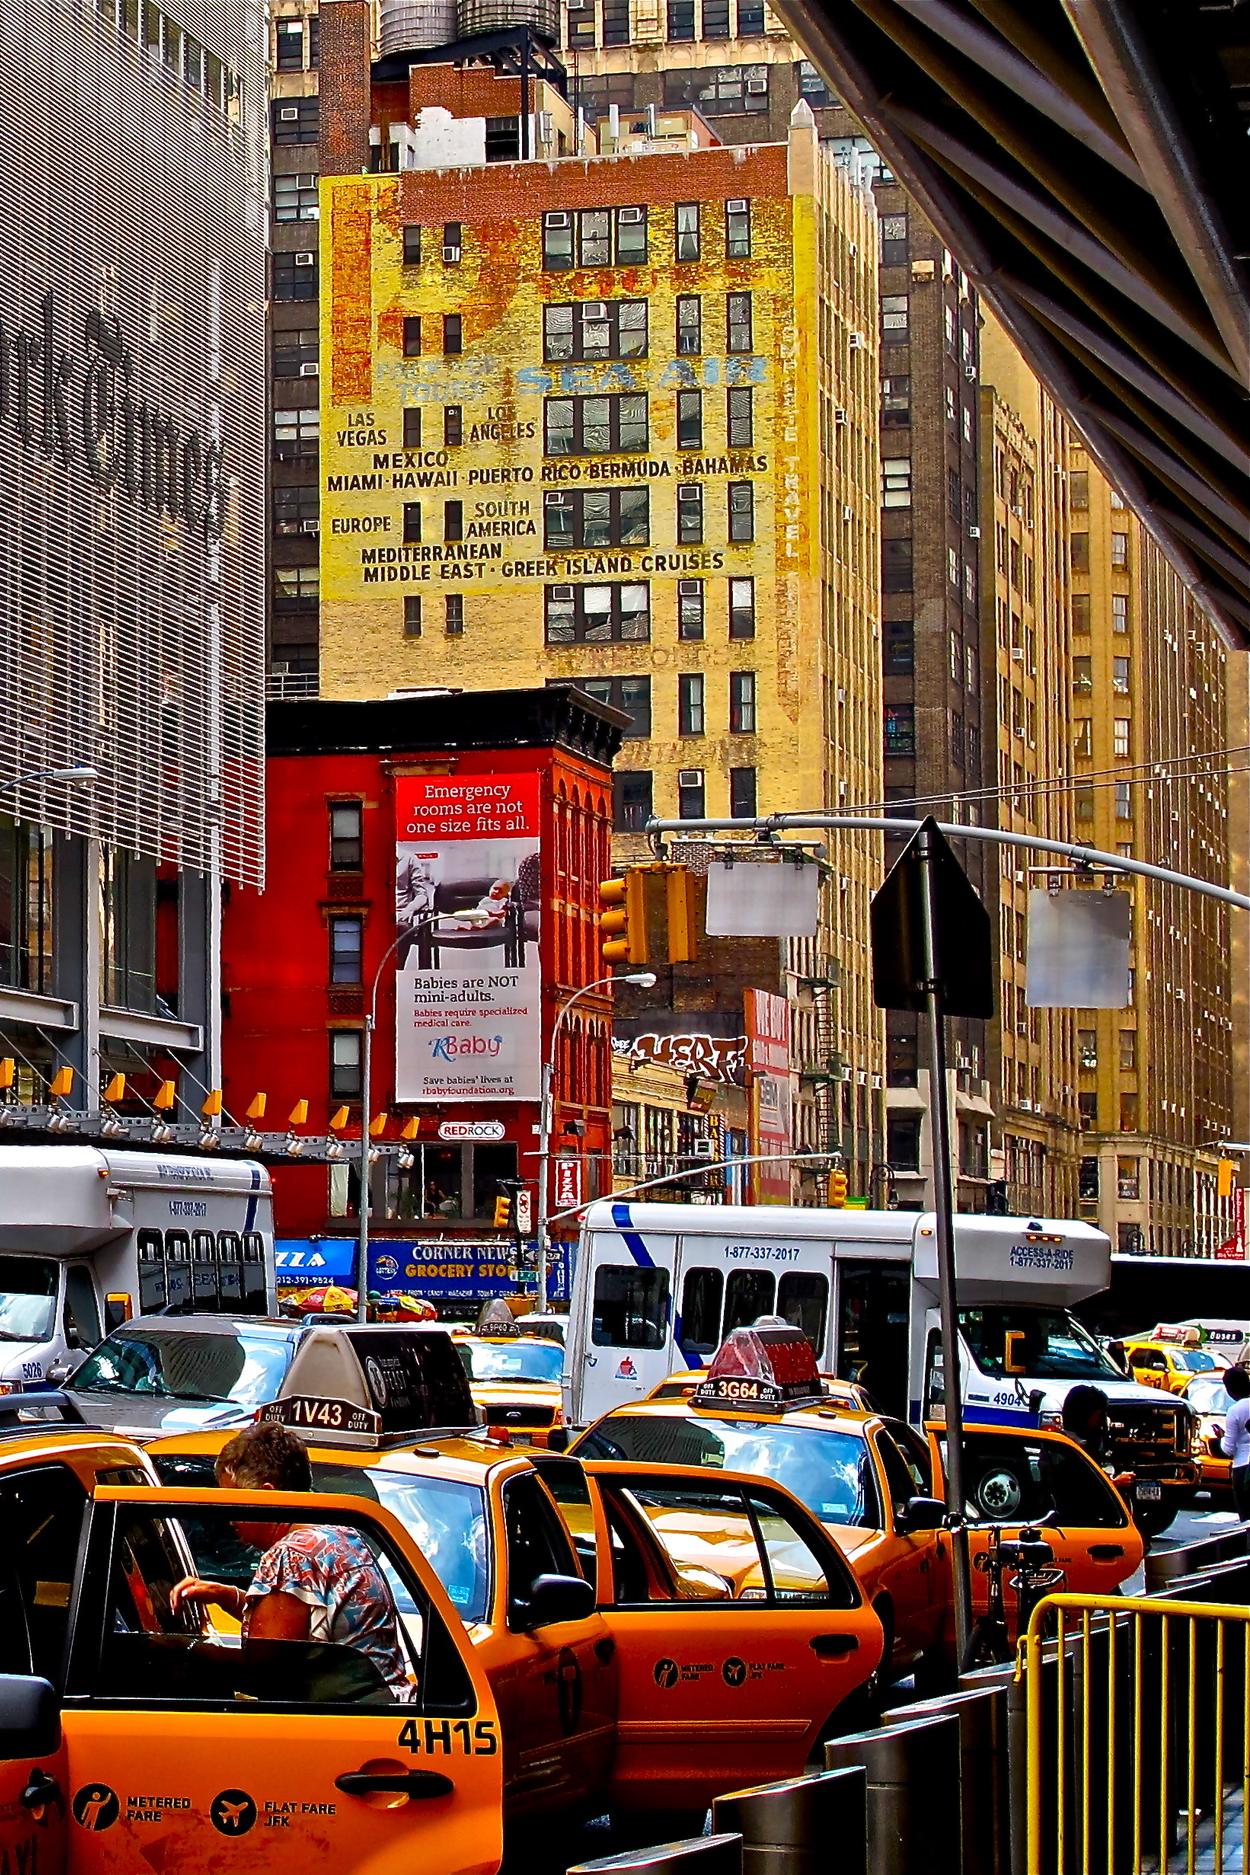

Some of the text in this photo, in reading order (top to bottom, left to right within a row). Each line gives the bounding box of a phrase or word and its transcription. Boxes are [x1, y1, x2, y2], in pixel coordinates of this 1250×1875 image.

[515, 355, 769, 394] SEA AIR
[347, 412, 375, 428] LAS
[488, 407, 516, 421] LOS
[336, 429, 387, 447] VEGAS
[468, 423, 536, 442] ANGELES
[372, 451, 449, 470] MEXICO
[327, 456, 768, 492] MIAMI HAWAII PUERTO RICO BERMUDA BAHAMAS
[475, 501, 530, 518] SOUTH
[331, 517, 392, 534] EUROPE
[466, 520, 537, 538] AMERICA
[361, 543, 503, 564] MEDITERRANEAN
[363, 553, 724, 582] MIDDLE EAST GREEK ISLAND CRUISES
[424, 785, 511, 800] Emergency
[413, 800, 523, 816] rooms are not
[406, 815, 530, 833] one size fits all.
[414, 976, 519, 989] Babies are NOT
[414, 990, 495, 1003] mini-adults.
[414, 1007, 528, 1019] Babies require specialized
[413, 1019, 449, 1027] medical
[423, 1076, 444, 1085] Save
[447, 1075, 478, 1084] babies'
[480, 1075, 501, 1083] lives
[422, 1085, 514, 1096] rbabyfoundation.org
[444, 1125, 500, 1136] REDROCK
[560, 1162, 575, 1199] PIZZA
[412, 1247, 473, 1260] CORNER
[477, 1246, 518, 1260] NEWS
[724, 1246, 800, 1261] 1-877-337-2017
[1010, 1246, 1074, 1260] ACCESS-A-RIDE
[405, 1264, 474, 1277] GROCERY
[1009, 1256, 1074, 1270] 1-877-337-2017
[1209, 1331, 1237, 1340] Buses
[21, 1362, 42, 1379] 5026
[717, 1381, 758, 1399] 3G64
[993, 1392, 1021, 1407] 4904
[269, 1405, 283, 1414] OFF
[292, 1401, 343, 1426] 1V43
[352, 1412, 366, 1421] OFF
[265, 1413, 286, 1423] DUTY
[348, 1420, 369, 1430] DUTY
[397, 1720, 498, 1756] 4H15
[126, 1797, 192, 1810] METERED
[264, 1800, 336, 1816] FLAT FARE
[126, 1810, 162, 1823] FARE
[263, 1815, 290, 1828] JFK
